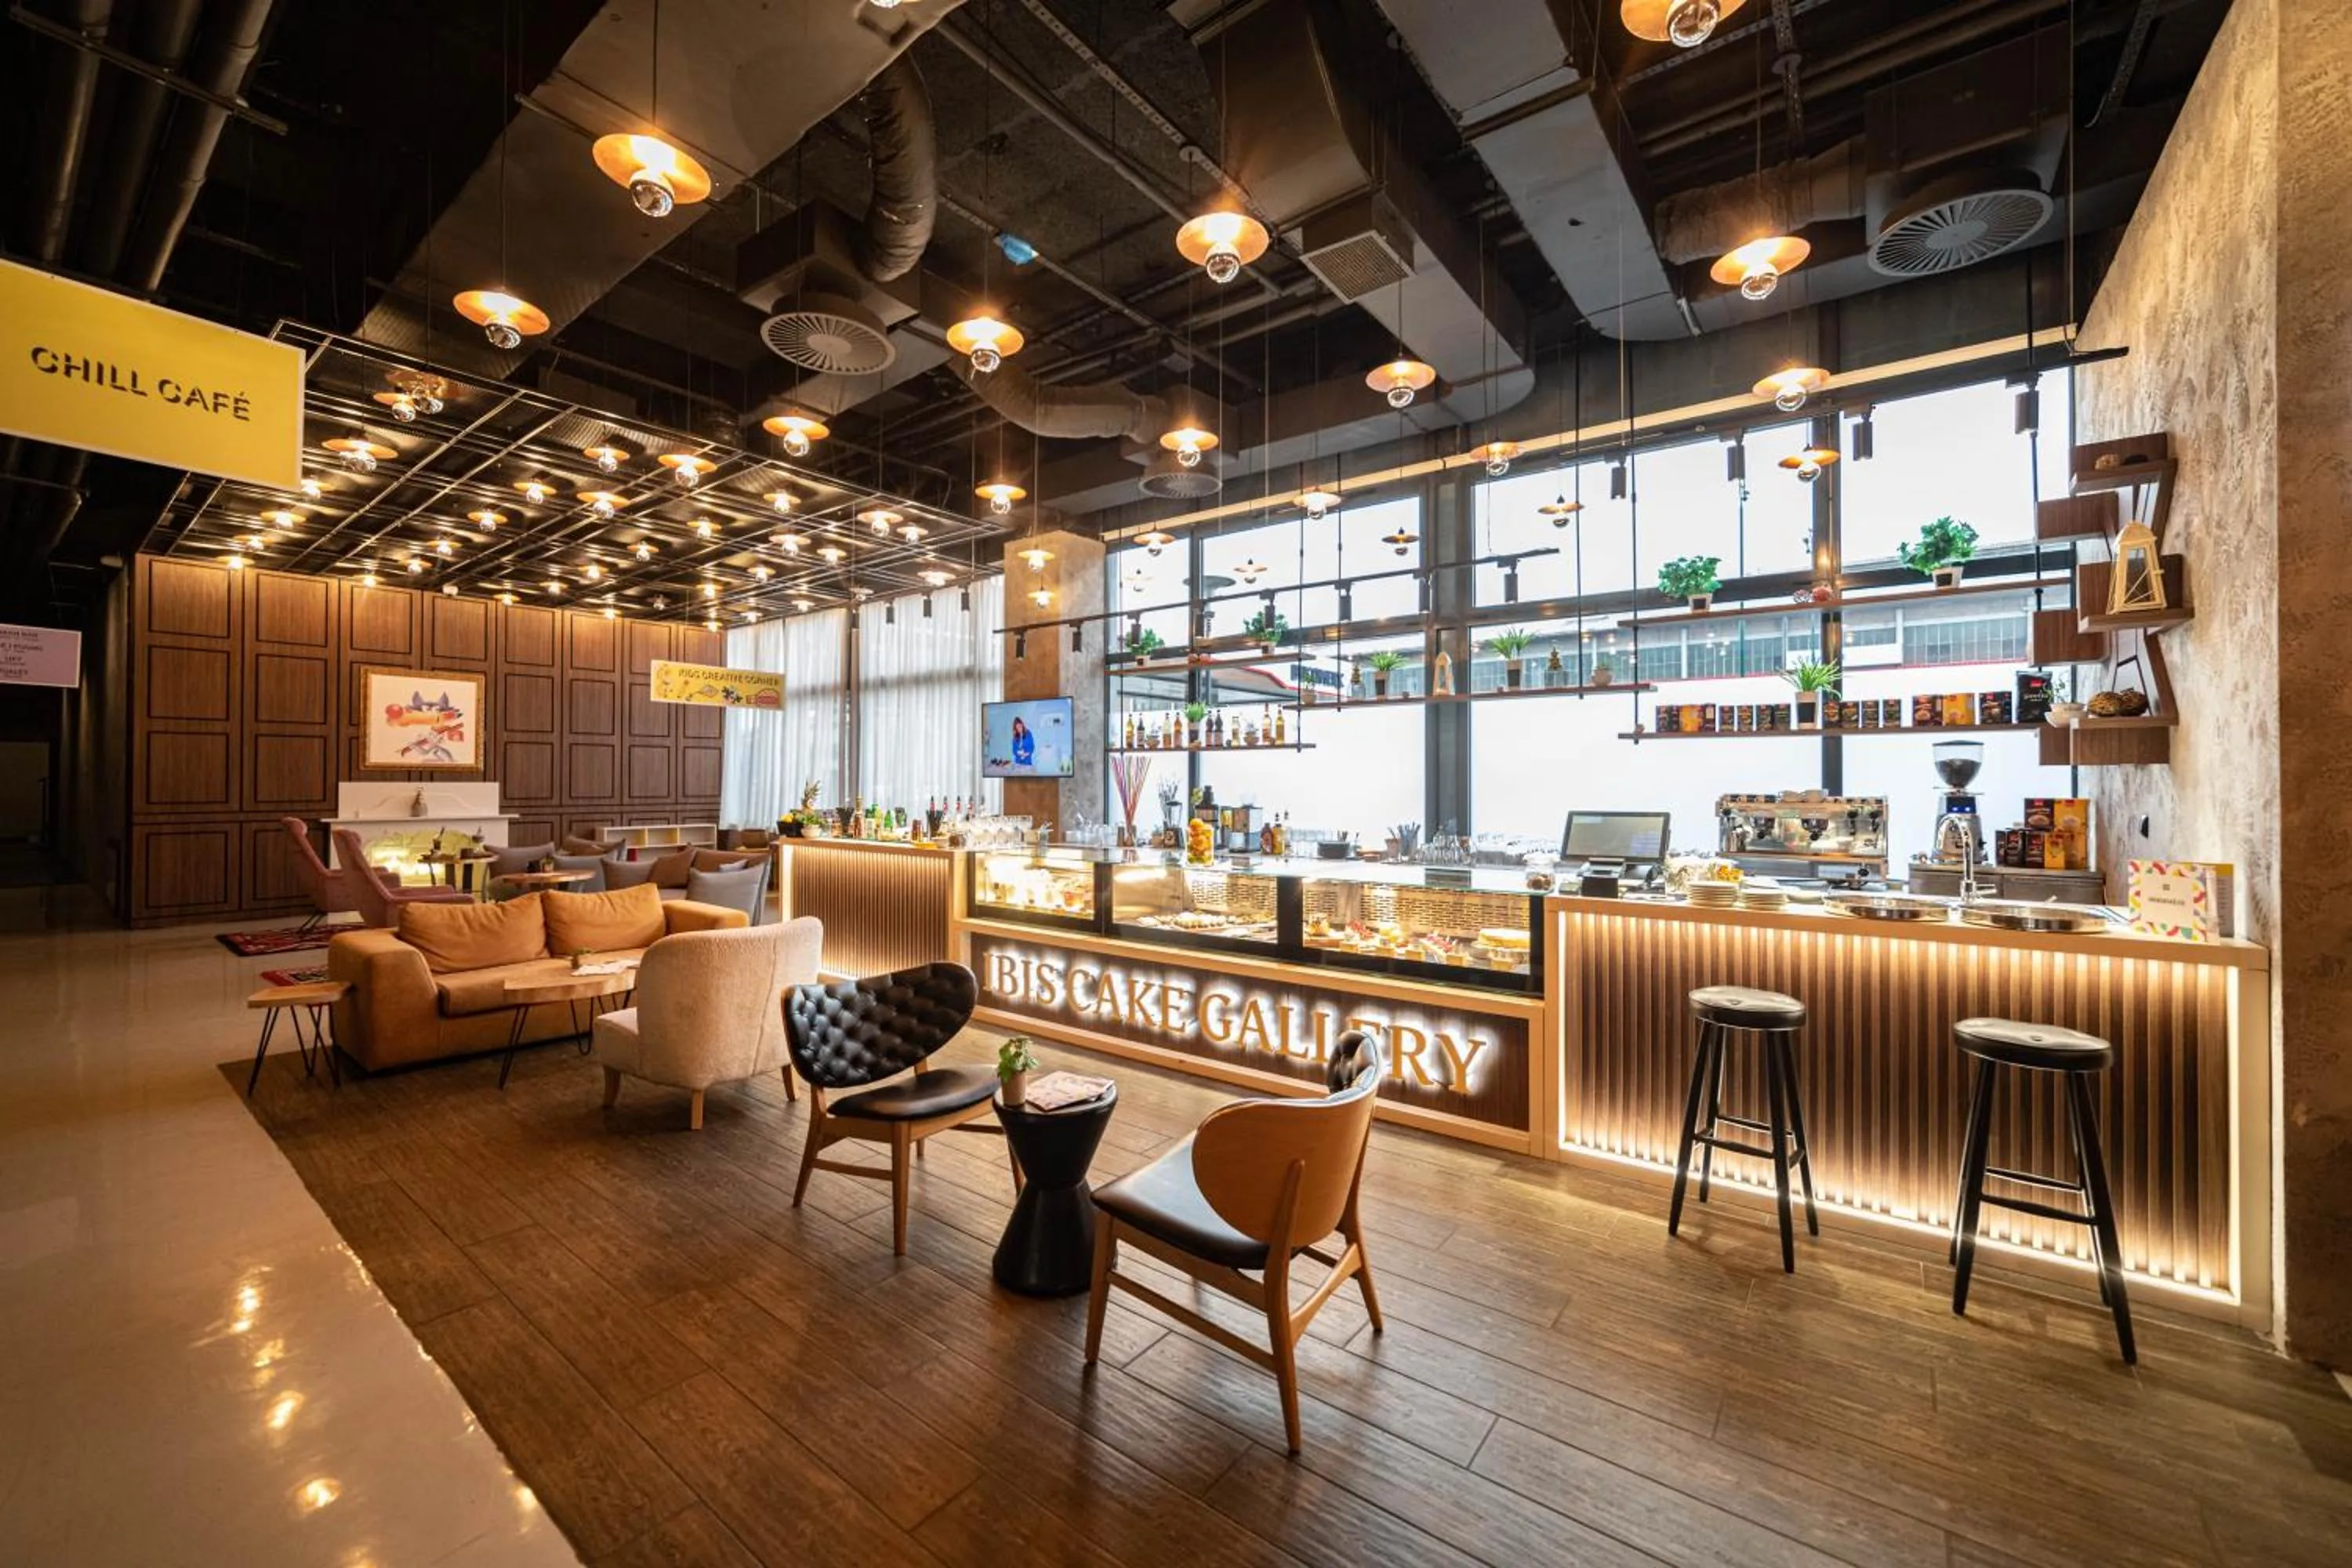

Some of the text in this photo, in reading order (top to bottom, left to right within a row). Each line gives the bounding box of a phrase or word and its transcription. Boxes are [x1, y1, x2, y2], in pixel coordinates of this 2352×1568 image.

[31, 347, 251, 422] CHILL CAFÉ
[702, 670, 743, 684] CREATIVE
[982, 952, 1058, 1005] IBIS
[1065, 967, 1193, 1033] CAKE
